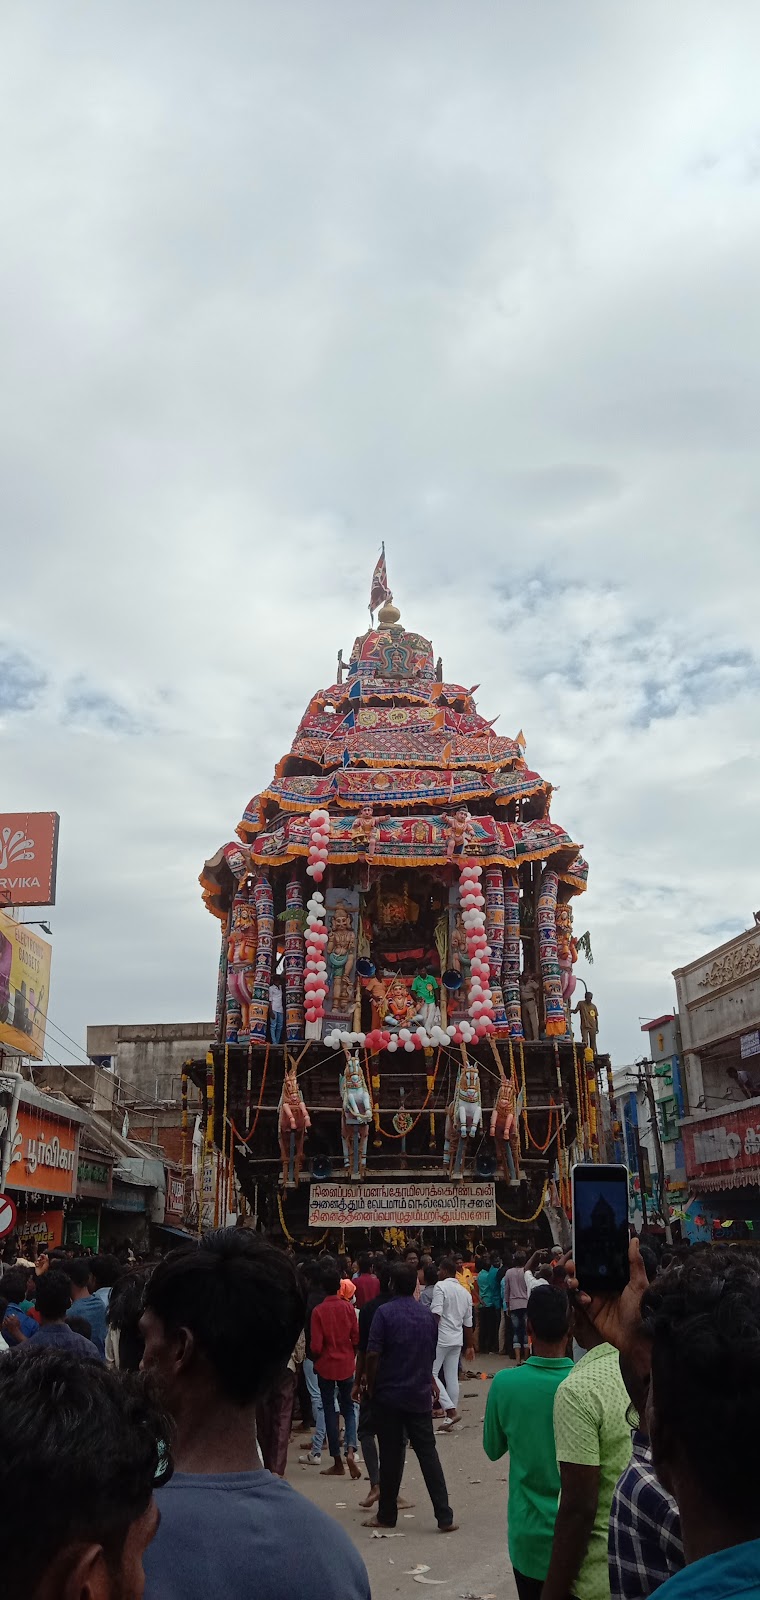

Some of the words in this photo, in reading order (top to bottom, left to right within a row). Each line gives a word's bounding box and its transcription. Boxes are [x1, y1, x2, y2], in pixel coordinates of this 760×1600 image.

[18, 946, 41, 974] GADGETS
[26, 1131, 76, 1174] பூர்விகா
[312, 1185, 362, 1198] நினைப்பவர்
[309, 1198, 365, 1212] அனைத்தும்
[367, 1197, 407, 1209] வேடமாம்
[12, 1221, 48, 1236] MEGA
